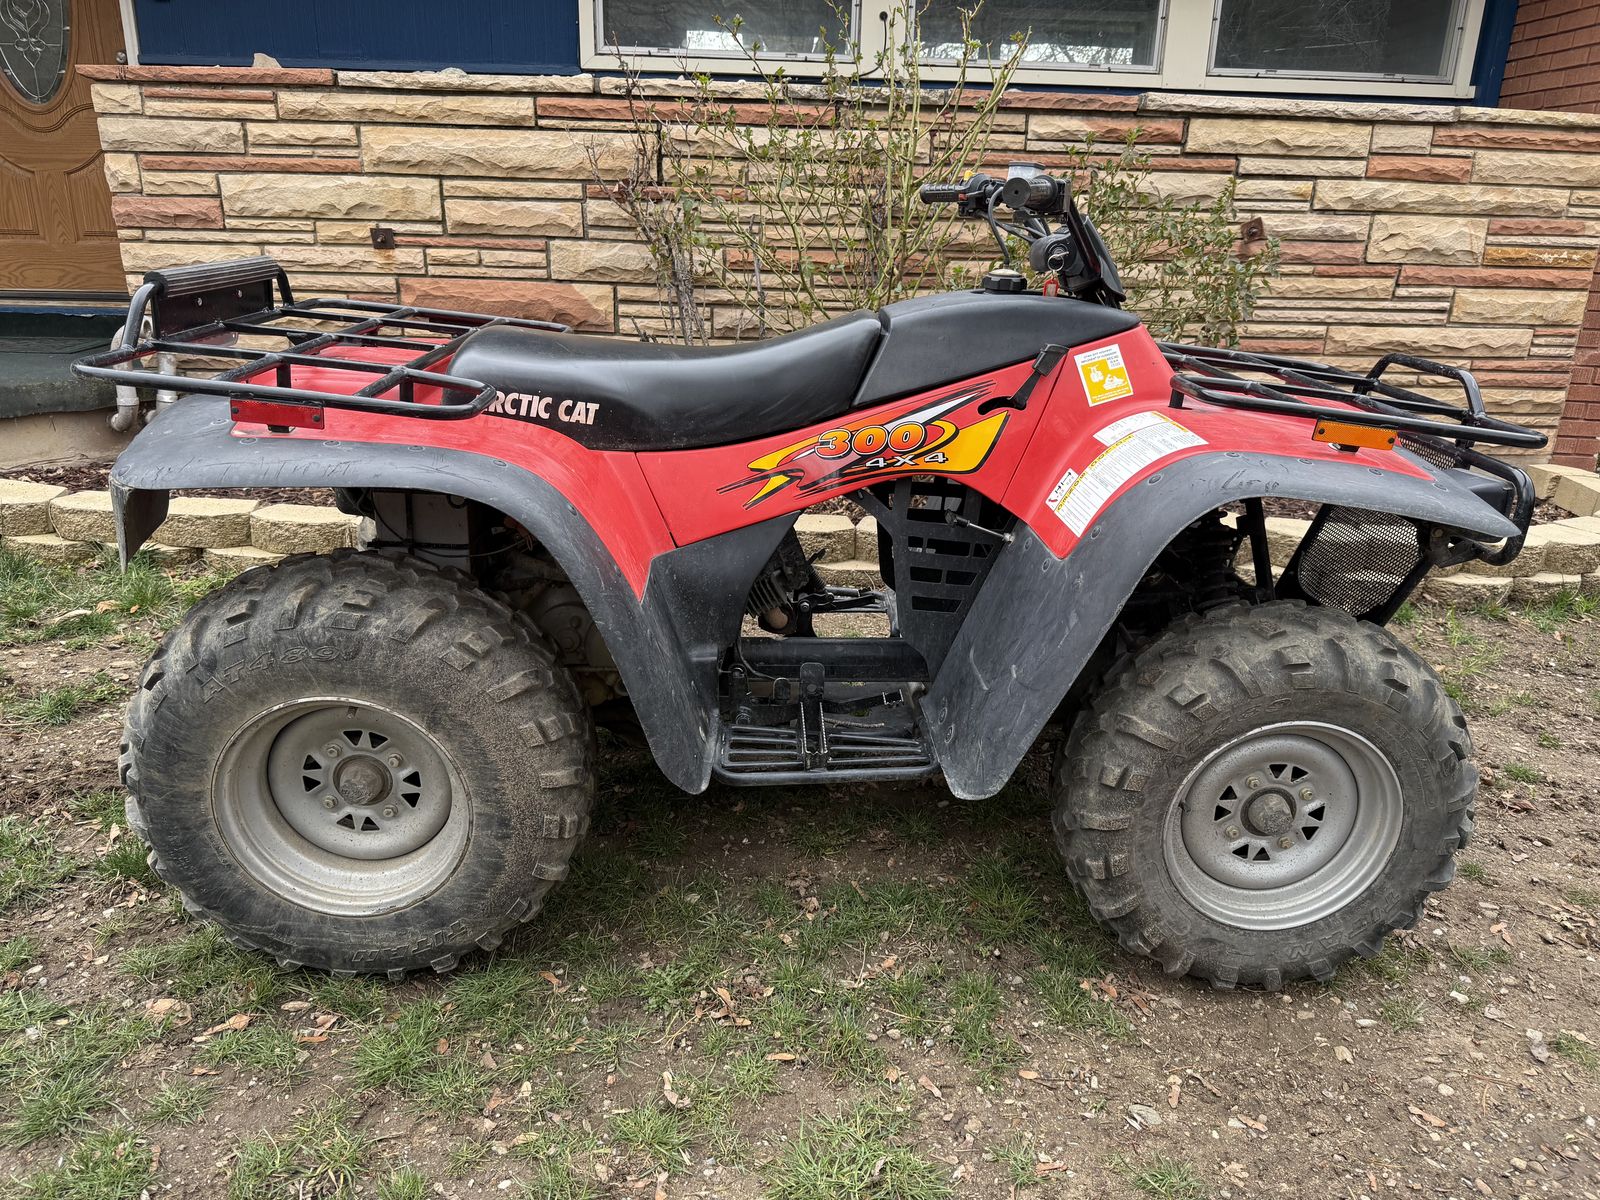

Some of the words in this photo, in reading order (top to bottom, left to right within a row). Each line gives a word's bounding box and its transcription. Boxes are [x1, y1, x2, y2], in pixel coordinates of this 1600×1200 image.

[478, 391, 553, 420] RCTIC
[558, 399, 600, 425] CAT
[814, 421, 927, 458] 300
